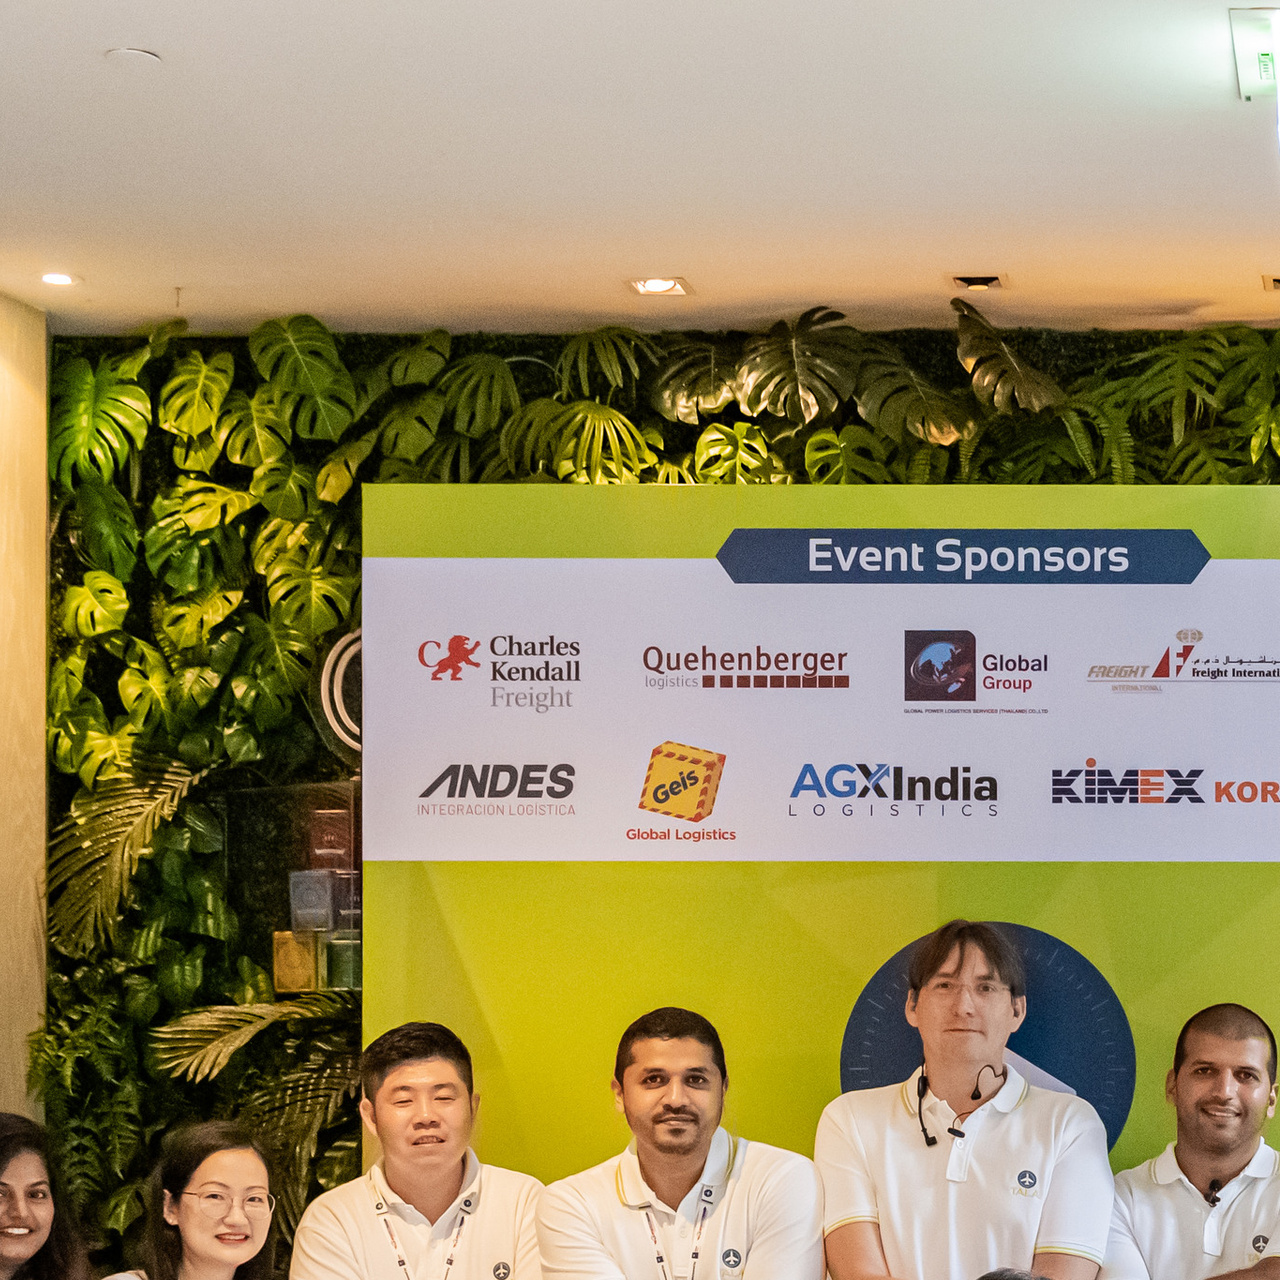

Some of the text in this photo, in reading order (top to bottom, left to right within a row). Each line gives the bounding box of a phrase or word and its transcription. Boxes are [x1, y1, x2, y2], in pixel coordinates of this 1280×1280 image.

[808, 538, 1130, 580] Event Sponsors
[489, 635, 581, 656] Charles
[642, 645, 848, 677] Quehenberger
[982, 654, 1048, 672] Global
[490, 661, 581, 681] Kendall
[1087, 665, 1150, 679] FREIGHT
[1192, 667, 1228, 680] Freight
[645, 675, 699, 690] logistics
[982, 675, 1033, 693] Group
[490, 686, 573, 714] Freight
[418, 763, 576, 799] ANDES
[652, 769, 700, 804] Geis
[788, 803, 999, 817] LOGISTICS
[626, 828, 737, 843] Global Logistics
